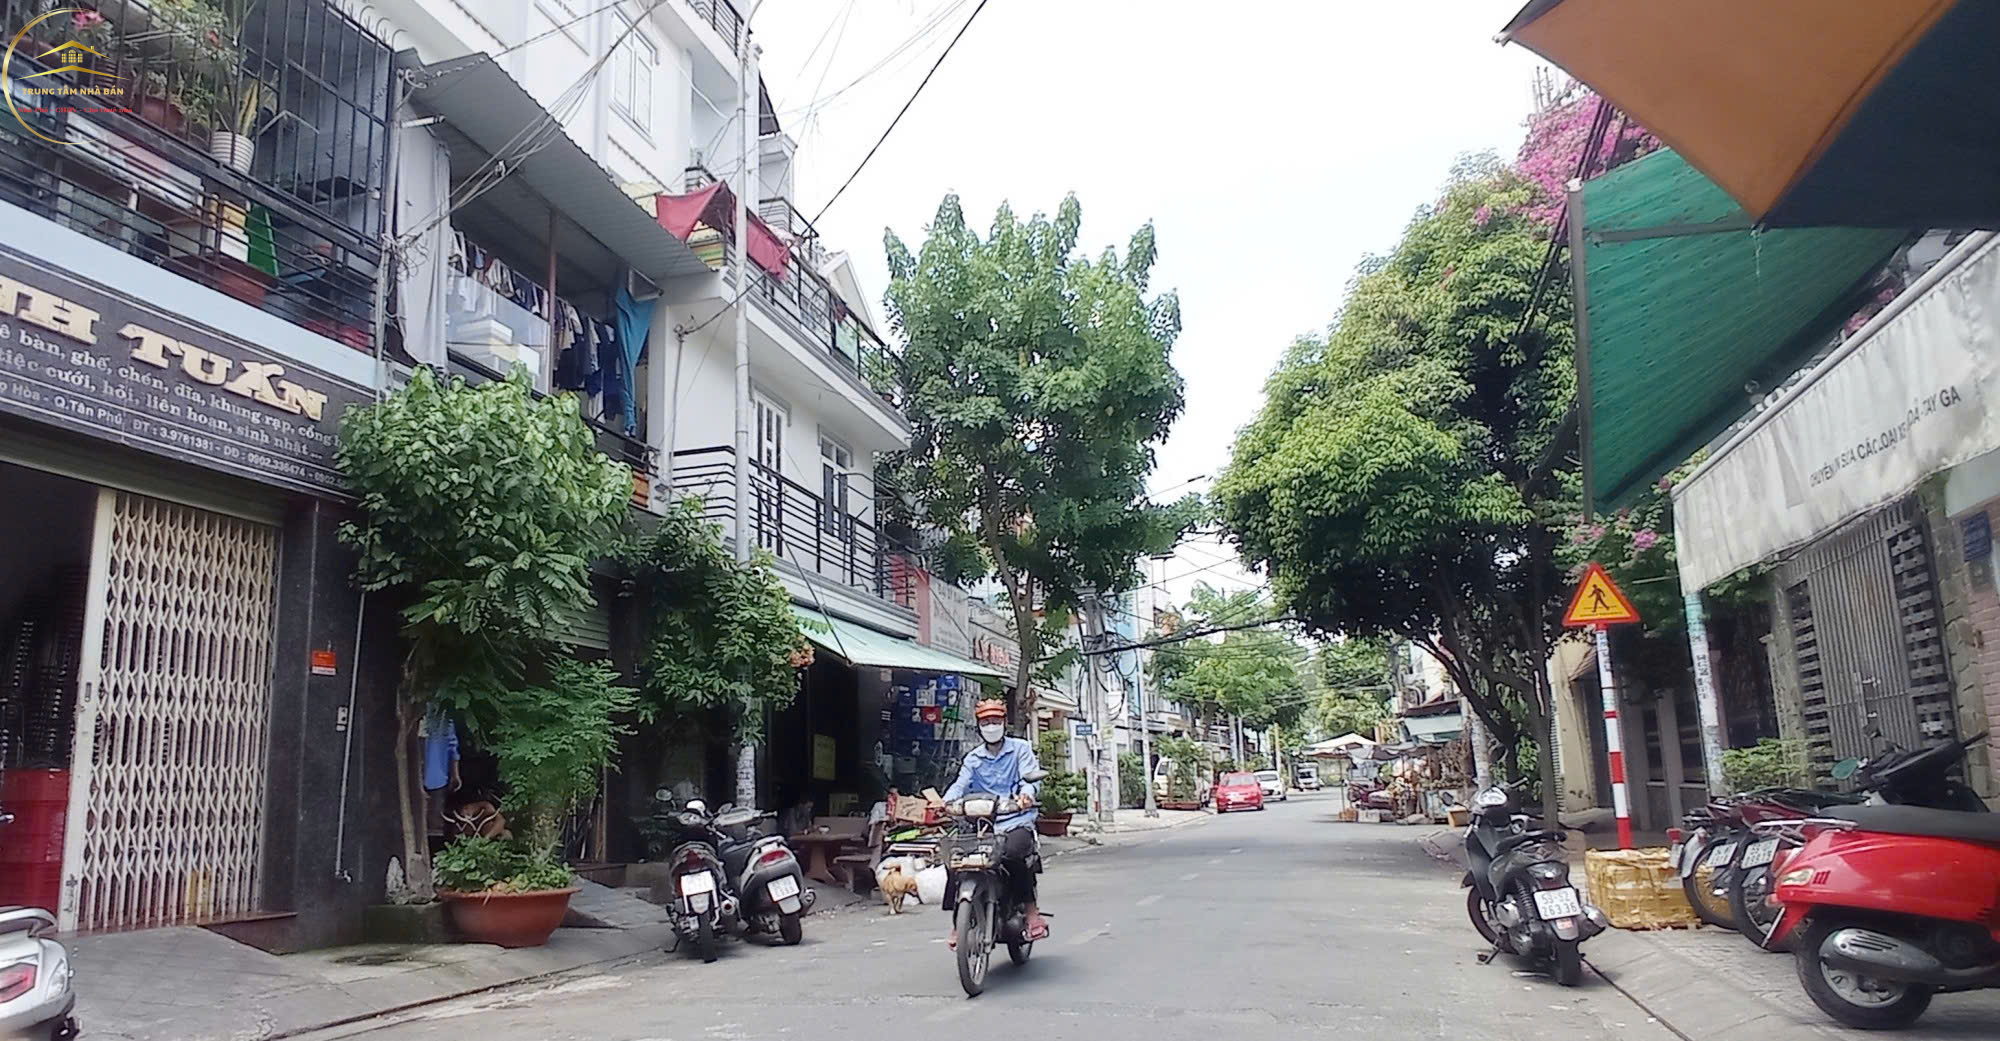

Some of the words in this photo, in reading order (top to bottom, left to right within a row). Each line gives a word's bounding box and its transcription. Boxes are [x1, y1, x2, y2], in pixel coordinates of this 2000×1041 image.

[19, 329, 67, 360] bàn,
[70, 350, 113, 375] ghế,
[118, 366, 169, 393] chén,
[209, 393, 264, 425] khung
[45, 364, 97, 392] cưới,
[147, 393, 181, 417] liên
[185, 407, 233, 433] hoan,
[236, 425, 270, 445] sinh
[1939, 385, 1961, 408] GA
